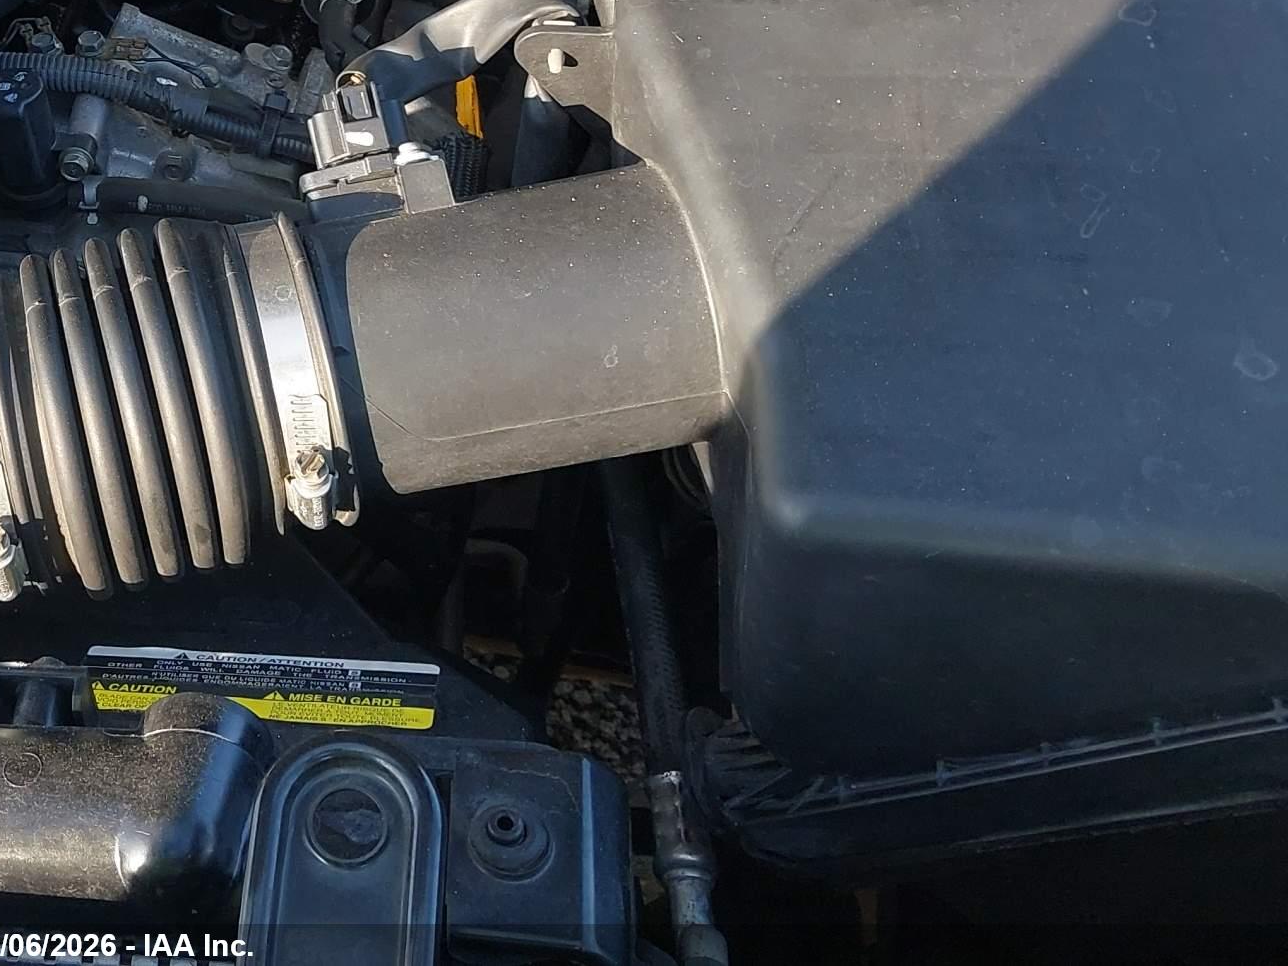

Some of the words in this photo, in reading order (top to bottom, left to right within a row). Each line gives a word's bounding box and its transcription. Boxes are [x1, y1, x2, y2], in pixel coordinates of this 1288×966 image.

[108, 682, 176, 693] CAUTION
[288, 692, 323, 702] MISE
[326, 694, 346, 704] EN
[349, 695, 401, 707] GARDE
